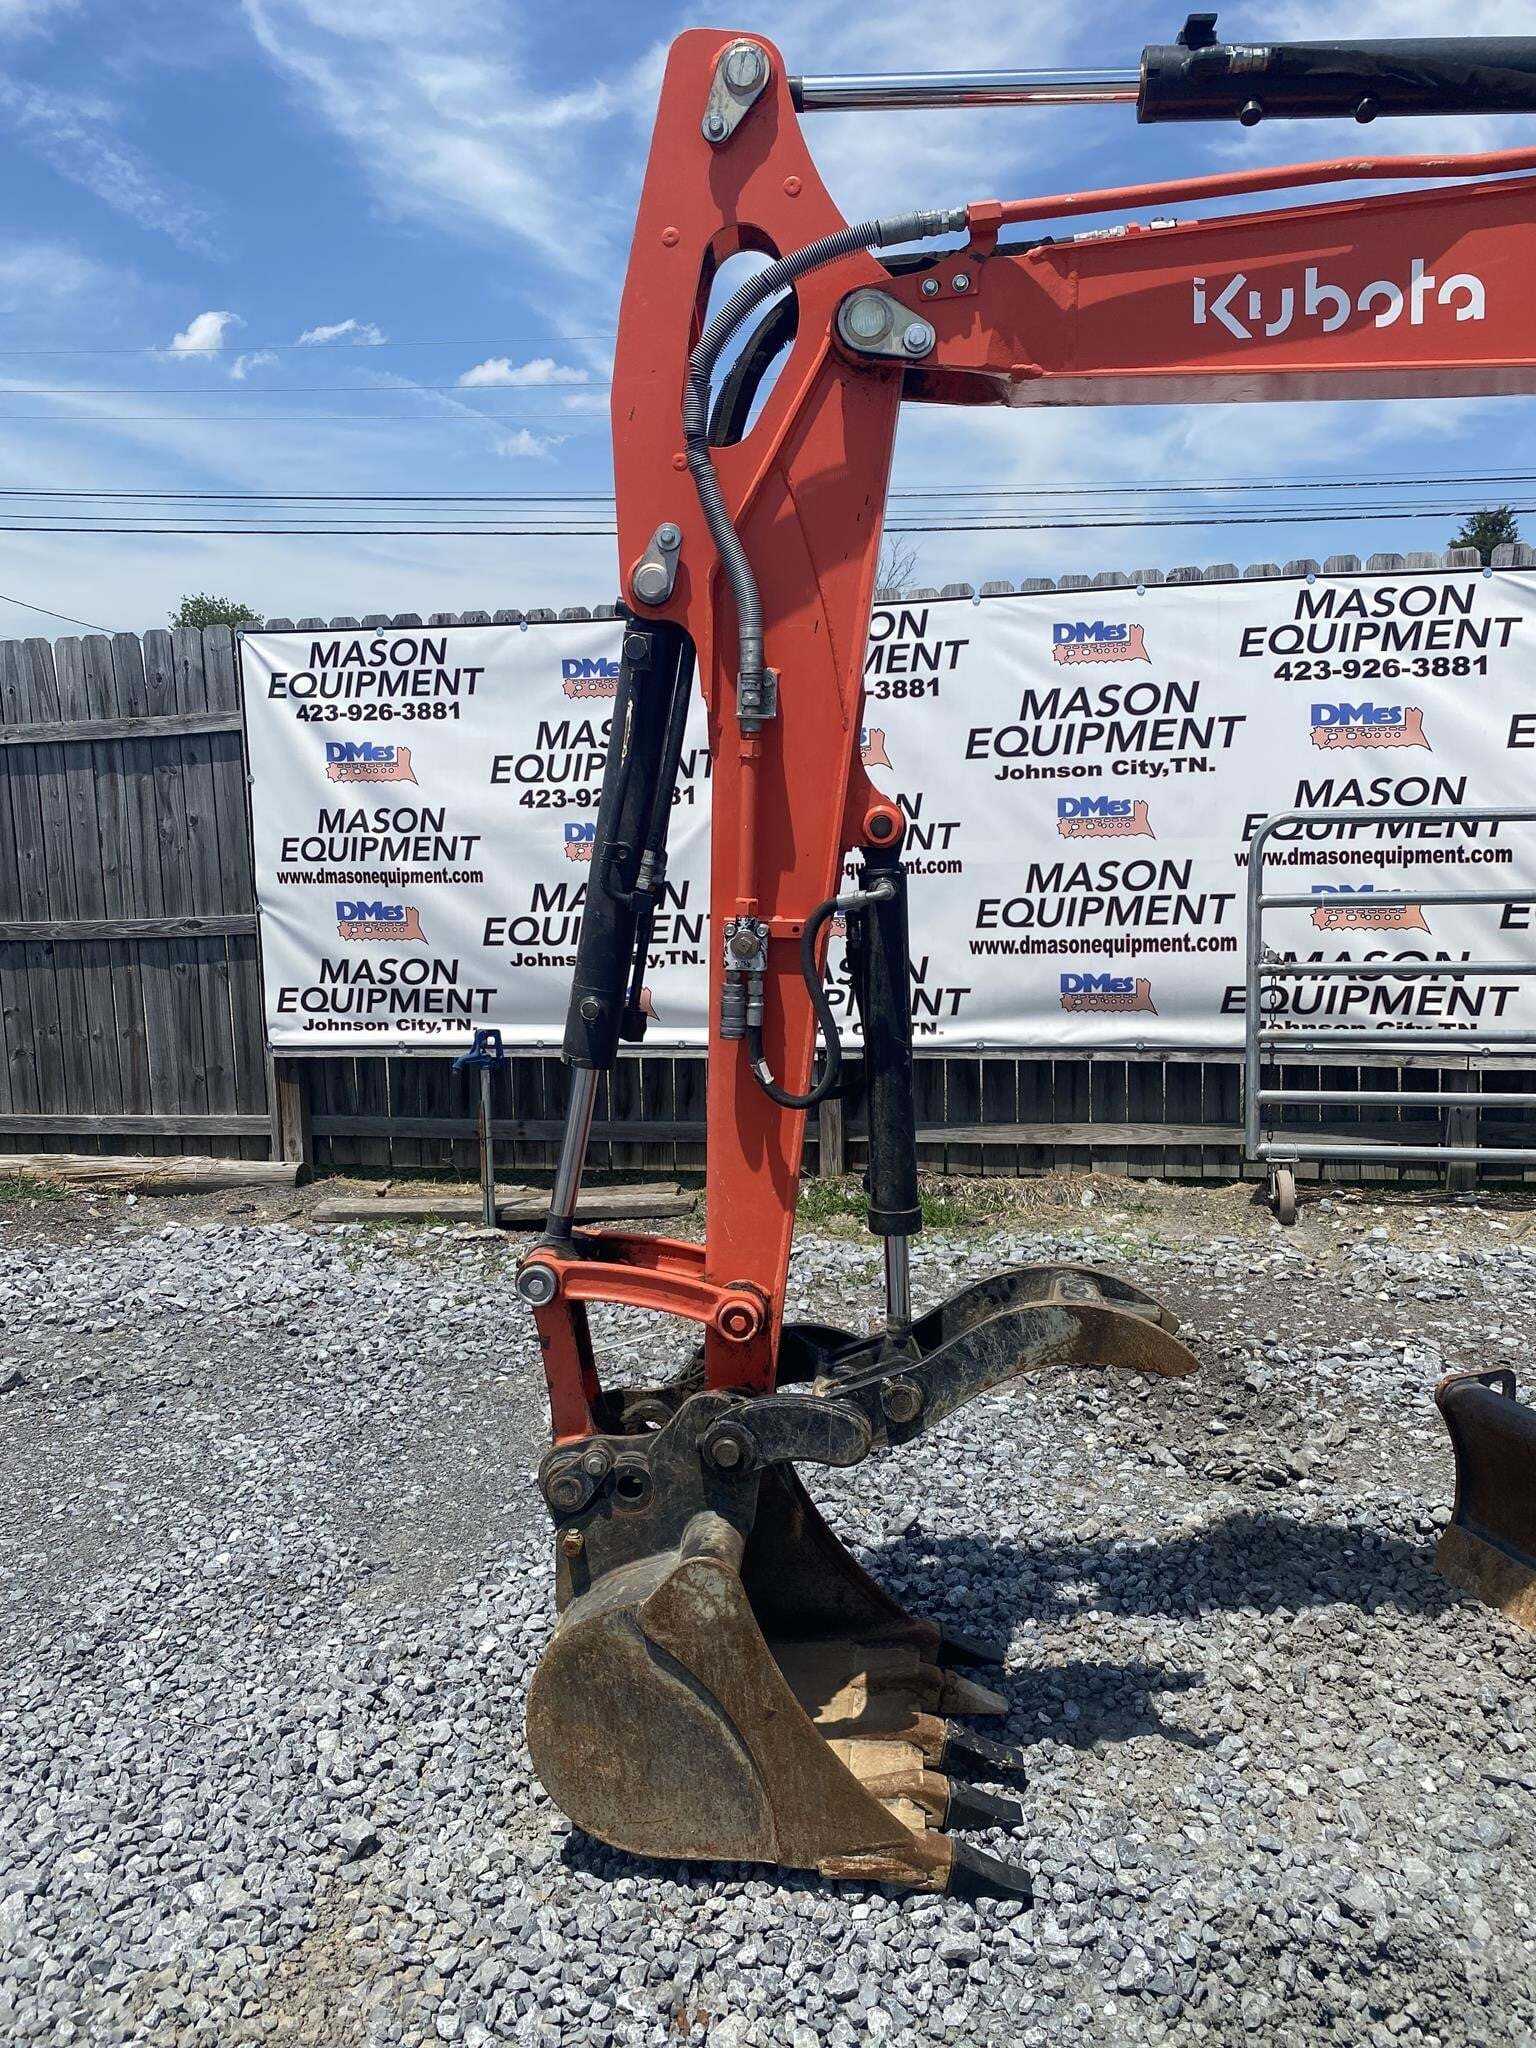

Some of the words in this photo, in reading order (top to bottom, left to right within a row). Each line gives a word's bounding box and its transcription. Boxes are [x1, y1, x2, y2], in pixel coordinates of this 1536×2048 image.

[1294, 583, 1476, 620] MASON
[1239, 617, 1522, 657] EQUIPMENT
[309, 637, 447, 668] MASON
[1274, 655, 1487, 681] 423-926-3881
[268, 667, 484, 698] EQUIPMENT
[296, 702, 460, 722] 423-926-3881
[1019, 681, 1200, 721] MASON
[965, 715, 1247, 760] EQUIPMENT
[994, 763, 1102, 781] Johnson
[1112, 757, 1216, 777] City,TN.
[1294, 776, 1467, 808] MASON
[318, 807, 446, 833] MASON
[281, 836, 481, 863] EQUIPMENT
[1235, 847, 1512, 869] ww.dmasonequipment.com
[277, 868, 483, 888] www.dmasonequipment.com
[1025, 859, 1193, 894] MASON
[975, 893, 1236, 929] EQUIPMENT
[969, 932, 1237, 958] www.dmasonequipment.com
[319, 958, 459, 985] MASON
[277, 987, 497, 1013] EQUIPMENT
[302, 1018, 390, 1032] Johnson
[395, 1018, 478, 1034] City,TN.
